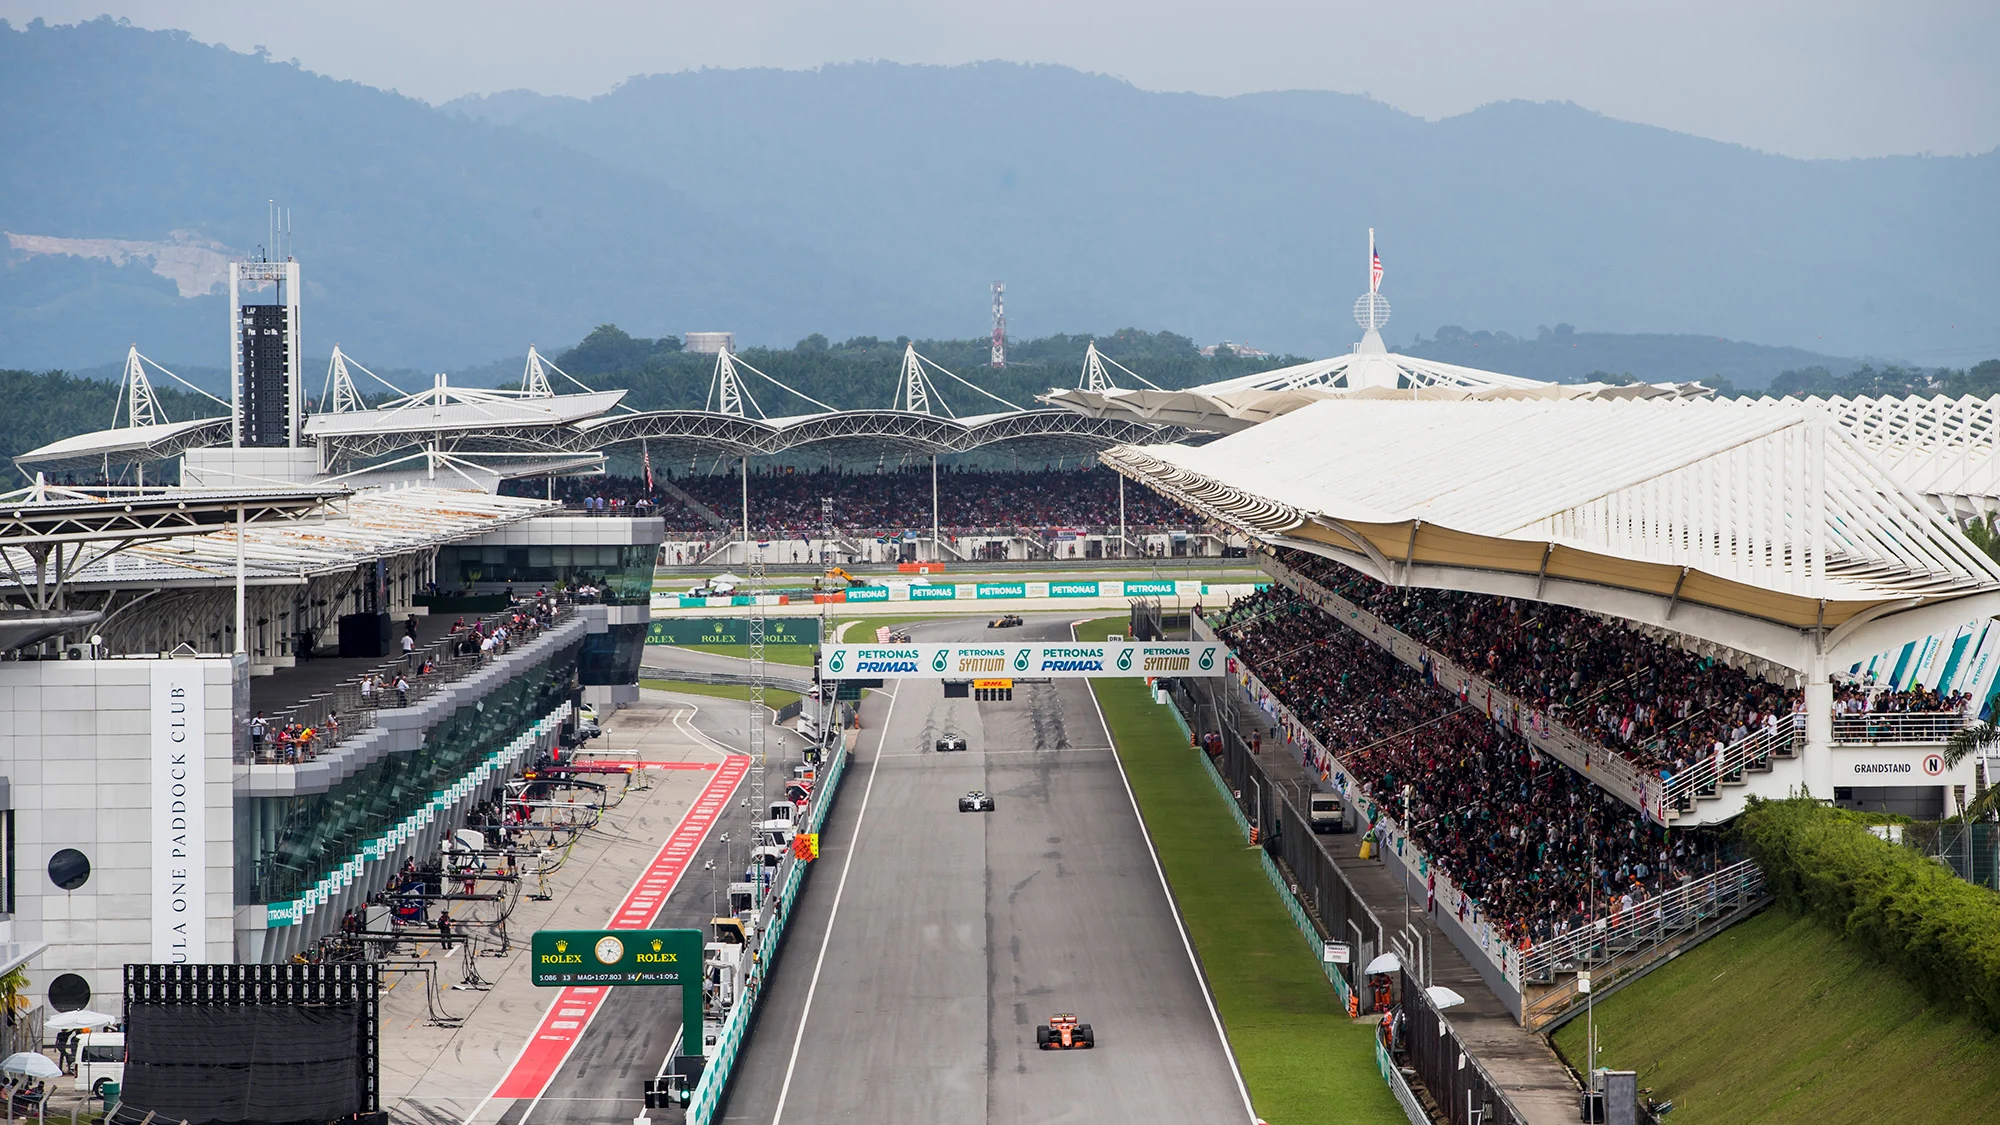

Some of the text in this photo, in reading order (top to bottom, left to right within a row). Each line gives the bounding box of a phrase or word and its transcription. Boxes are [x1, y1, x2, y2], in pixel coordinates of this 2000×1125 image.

[912, 588, 953, 597] PETRONAS
[980, 586, 1022, 596] PETRONAS
[1052, 585, 1096, 594] PETRONAS
[1126, 584, 1172, 593] PETRONAS
[849, 589, 887, 599] PETRONAS
[701, 634, 737, 643] ROLEX
[763, 634, 797, 643] ROLEX
[858, 649, 919, 659] PETRONAS
[958, 649, 1005, 657] PETRONAS
[1043, 648, 1104, 658] PETRONAS
[1143, 648, 1190, 656] PETRONAS
[1923, 638, 1939, 669] PETRONAS
[856, 661, 920, 673] PRIMAX
[958, 658, 1005, 672] SYNTIUM
[1041, 660, 1104, 671] PRIMAX
[1143, 657, 1190, 671] SYNTIUM
[1972, 653, 1989, 685] PETRONAS
[1854, 758, 1938, 774] GRANDSTAND N
[171, 688, 186, 963] ULA ONE PADDOCK CLUB
[268, 908, 293, 921] ETRONAS
[541, 954, 582, 964] ROLEX
[636, 953, 678, 963] ROLEX
